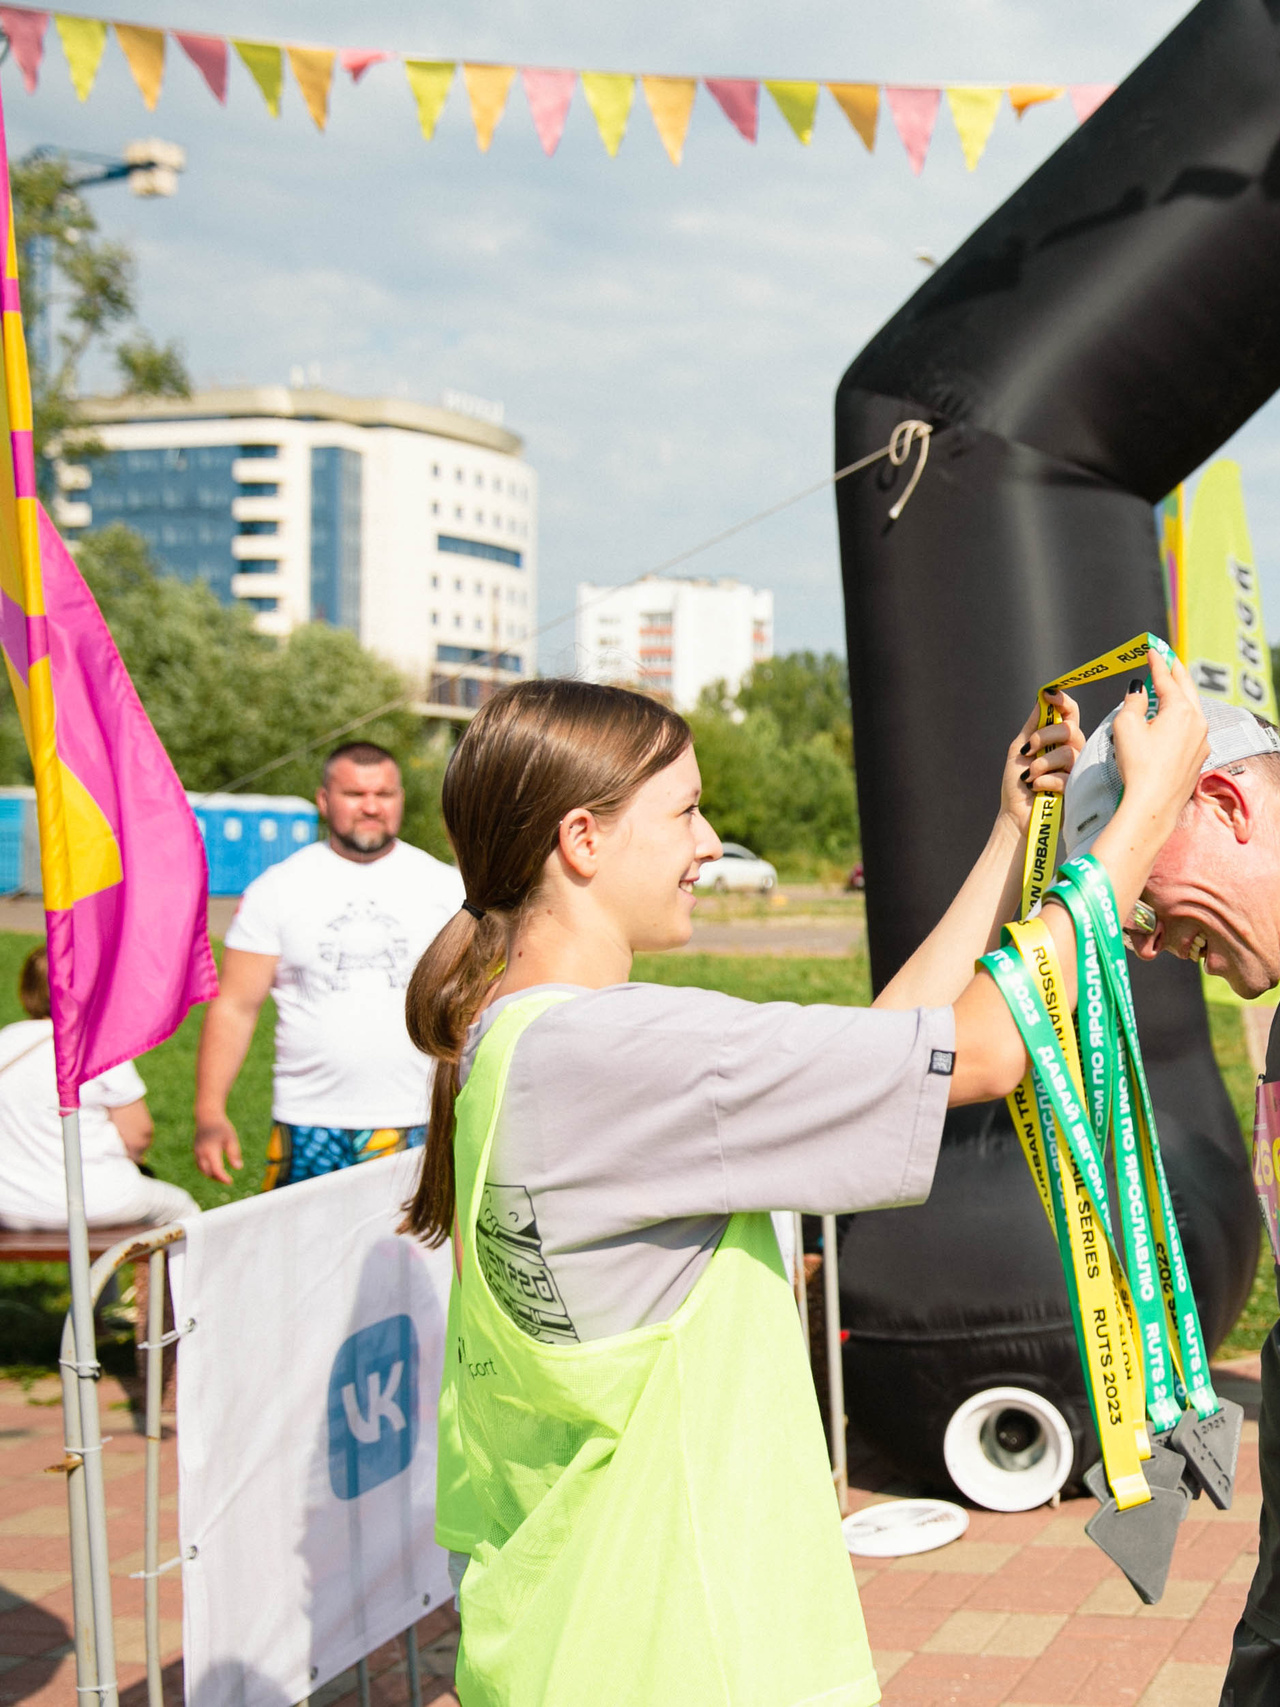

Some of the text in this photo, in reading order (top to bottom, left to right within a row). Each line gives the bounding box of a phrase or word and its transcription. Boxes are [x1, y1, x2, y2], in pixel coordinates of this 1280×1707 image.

[1079, 664, 1109, 679] 2023
[1033, 823, 1051, 882] URBAN
[1091, 1051, 1105, 1085] ПО
[1036, 1045, 1080, 1123] ДАВАЙ
[1071, 1123, 1104, 1200] БЕГОМ
[1120, 1117, 1136, 1152] ПО
[1078, 1200, 1100, 1279] SERIES
[1124, 1153, 1155, 1301] ЯРОСЛАВЛЮ
[1093, 1308, 1113, 1368] RUTS
[1103, 1373, 1123, 1426] 2023
[1145, 1322, 1166, 1383] RUTS
[1184, 1312, 1202, 1373] RUTS
